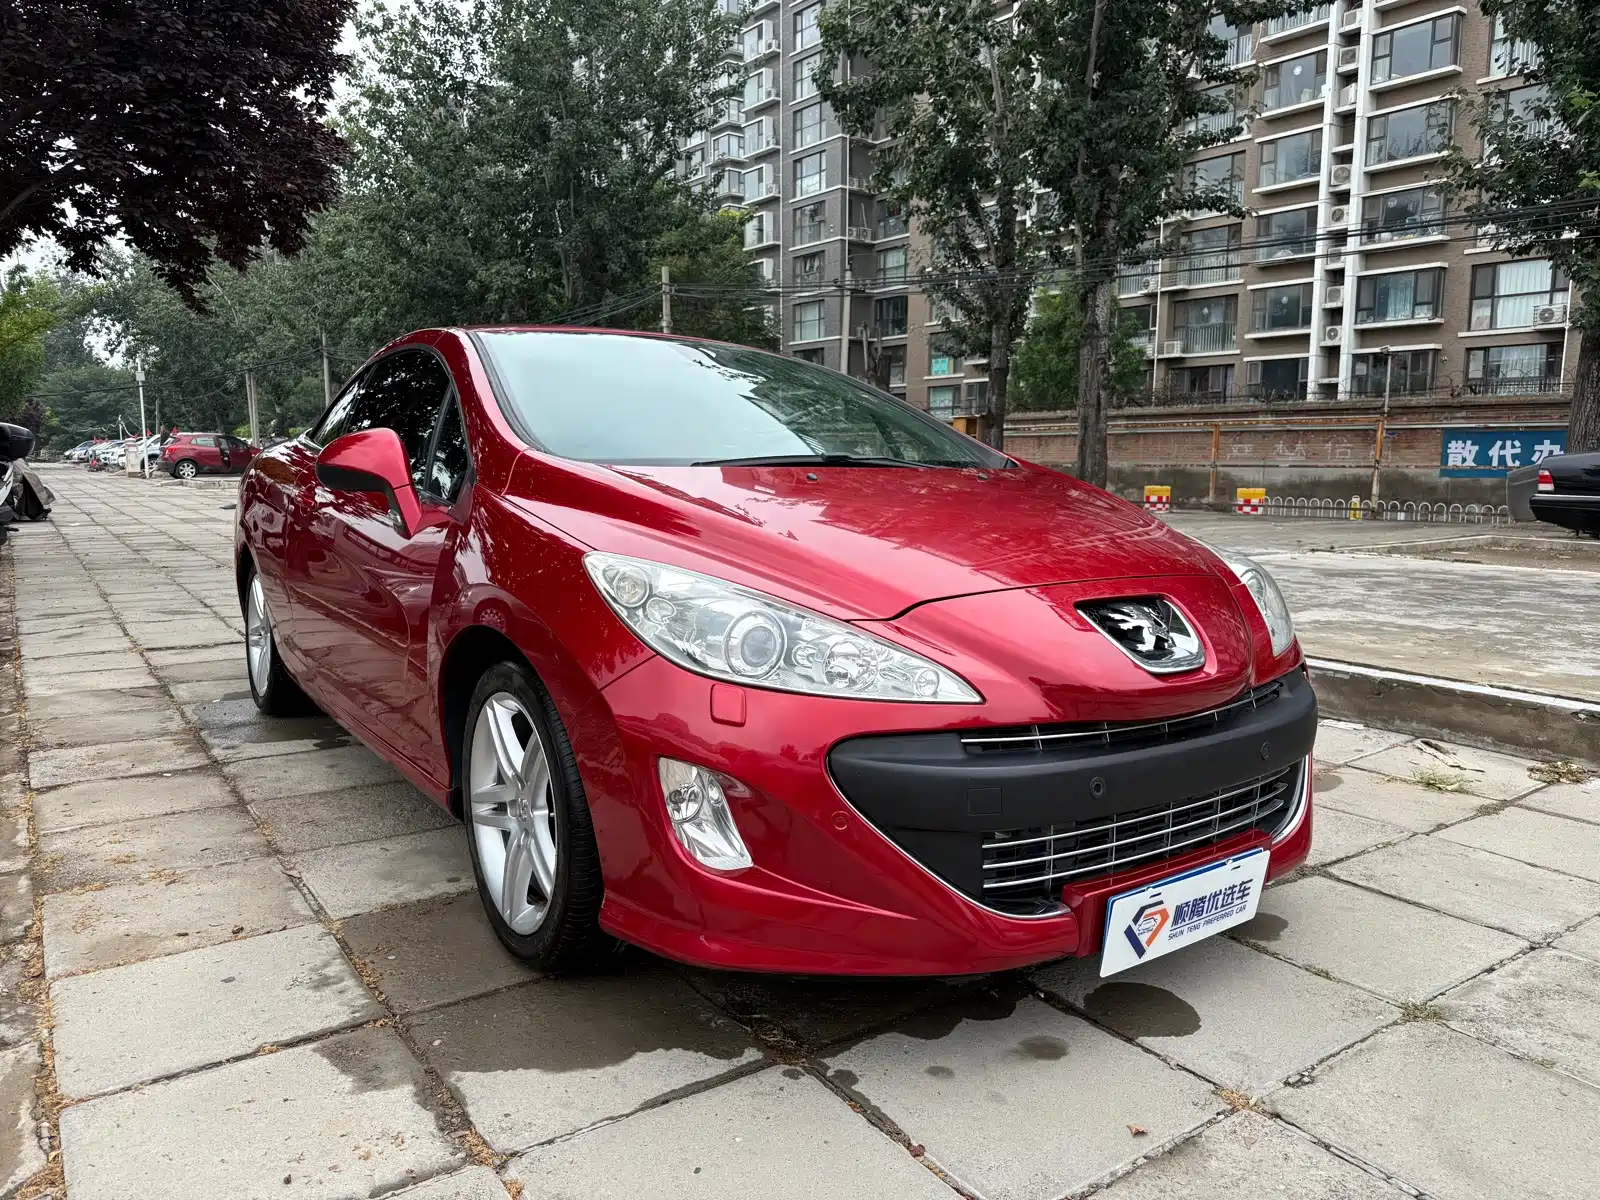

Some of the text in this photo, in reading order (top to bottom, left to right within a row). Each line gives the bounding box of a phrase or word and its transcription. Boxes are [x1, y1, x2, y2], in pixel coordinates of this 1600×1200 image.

[1168, 905, 1247, 941] SHUN TENG PREFERRED CAR
[1171, 878, 1253, 928] 顺腾优选车
